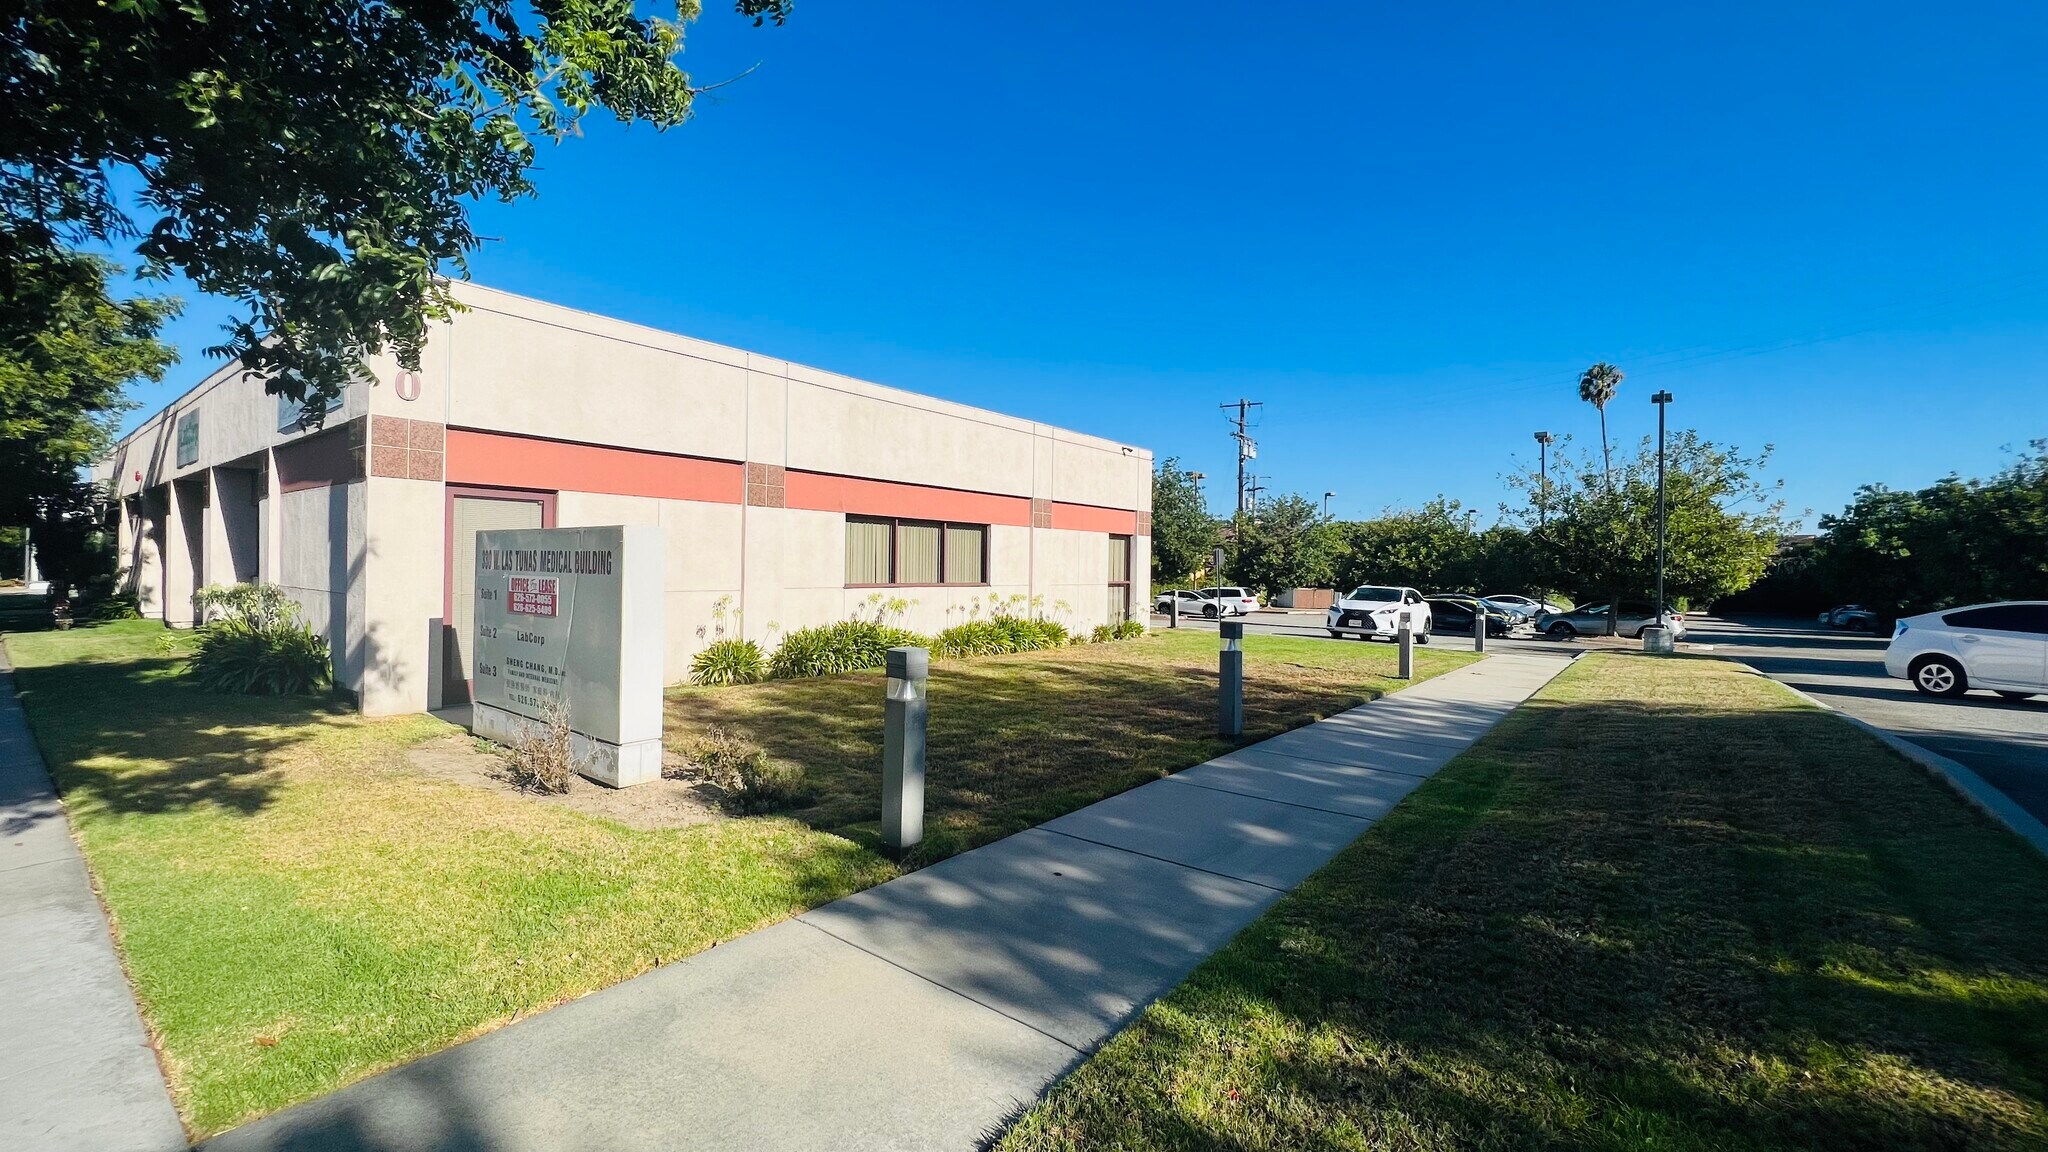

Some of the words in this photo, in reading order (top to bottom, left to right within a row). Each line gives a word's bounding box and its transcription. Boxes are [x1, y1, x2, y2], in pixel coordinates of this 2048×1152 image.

[501, 550, 512, 571] LAS
[515, 550, 537, 572] TUNAS
[541, 550, 572, 573] MEDICAL
[575, 551, 612, 575] BUILDING
[511, 577, 529, 592] OFFICE
[538, 579, 556, 594] LEASE
[480, 588, 493, 600] Suite
[493, 589, 497, 601] 1
[480, 625, 492, 638] Suite
[492, 627, 497, 639] 2
[516, 630, 545, 646] LabCorp
[479, 662, 491, 676] Suite
[492, 665, 497, 677] 3
[506, 656, 524, 668] SHENG
[525, 661, 547, 674] CHANG,
